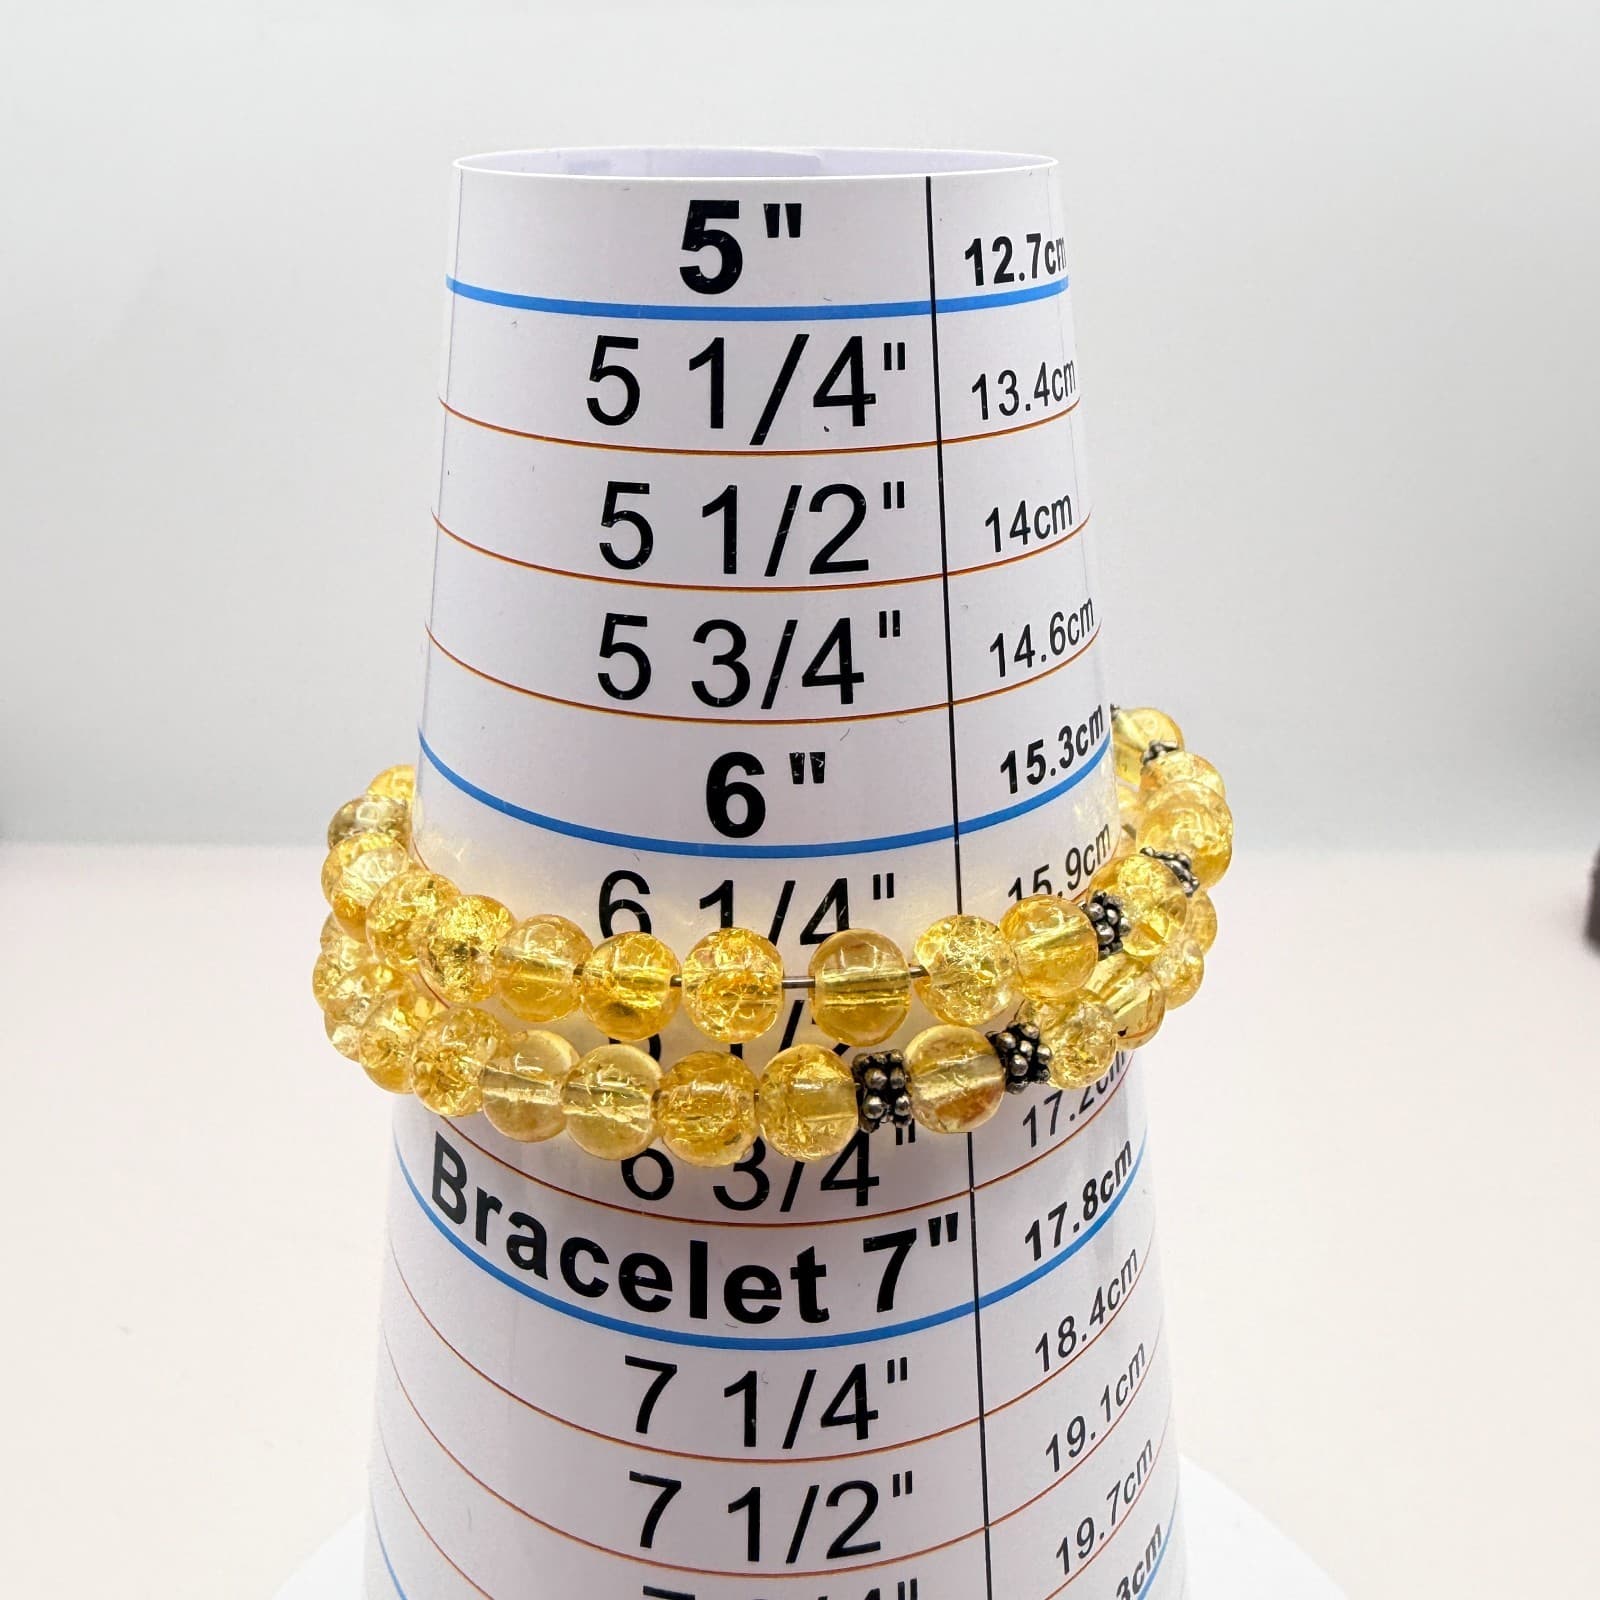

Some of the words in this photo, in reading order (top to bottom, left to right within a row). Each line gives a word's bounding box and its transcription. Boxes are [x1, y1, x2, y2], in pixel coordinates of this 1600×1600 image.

[679, 199, 803, 296] 5"
[964, 232, 1067, 287] 12.7cm
[586, 334, 641, 427] 5
[688, 333, 907, 446] 1/4"
[971, 359, 1077, 421] 13.4cm
[598, 481, 653, 571] 5
[701, 480, 906, 578] 1/2"
[985, 494, 1073, 553] 14cm
[597, 613, 652, 702] 5
[691, 609, 901, 711] 3/4"
[989, 597, 1095, 678] 14.6cm
[705, 751, 828, 839] 6"
[1000, 704, 1104, 795] 15.3cm
[598, 869, 652, 939] 6
[431, 1130, 829, 1325] Bracelet
[862, 1210, 960, 1314] 7"
[1025, 1140, 1133, 1262] 17.8cm
[1034, 1248, 1138, 1373] 18.4cm
[623, 1354, 679, 1436] 7
[723, 1356, 909, 1451] 1/4"
[1045, 1342, 1146, 1473] 19.1cm
[628, 1469, 682, 1549] 7
[727, 1470, 914, 1565] 1/2"
[1055, 1439, 1153, 1576] 19.7cm
